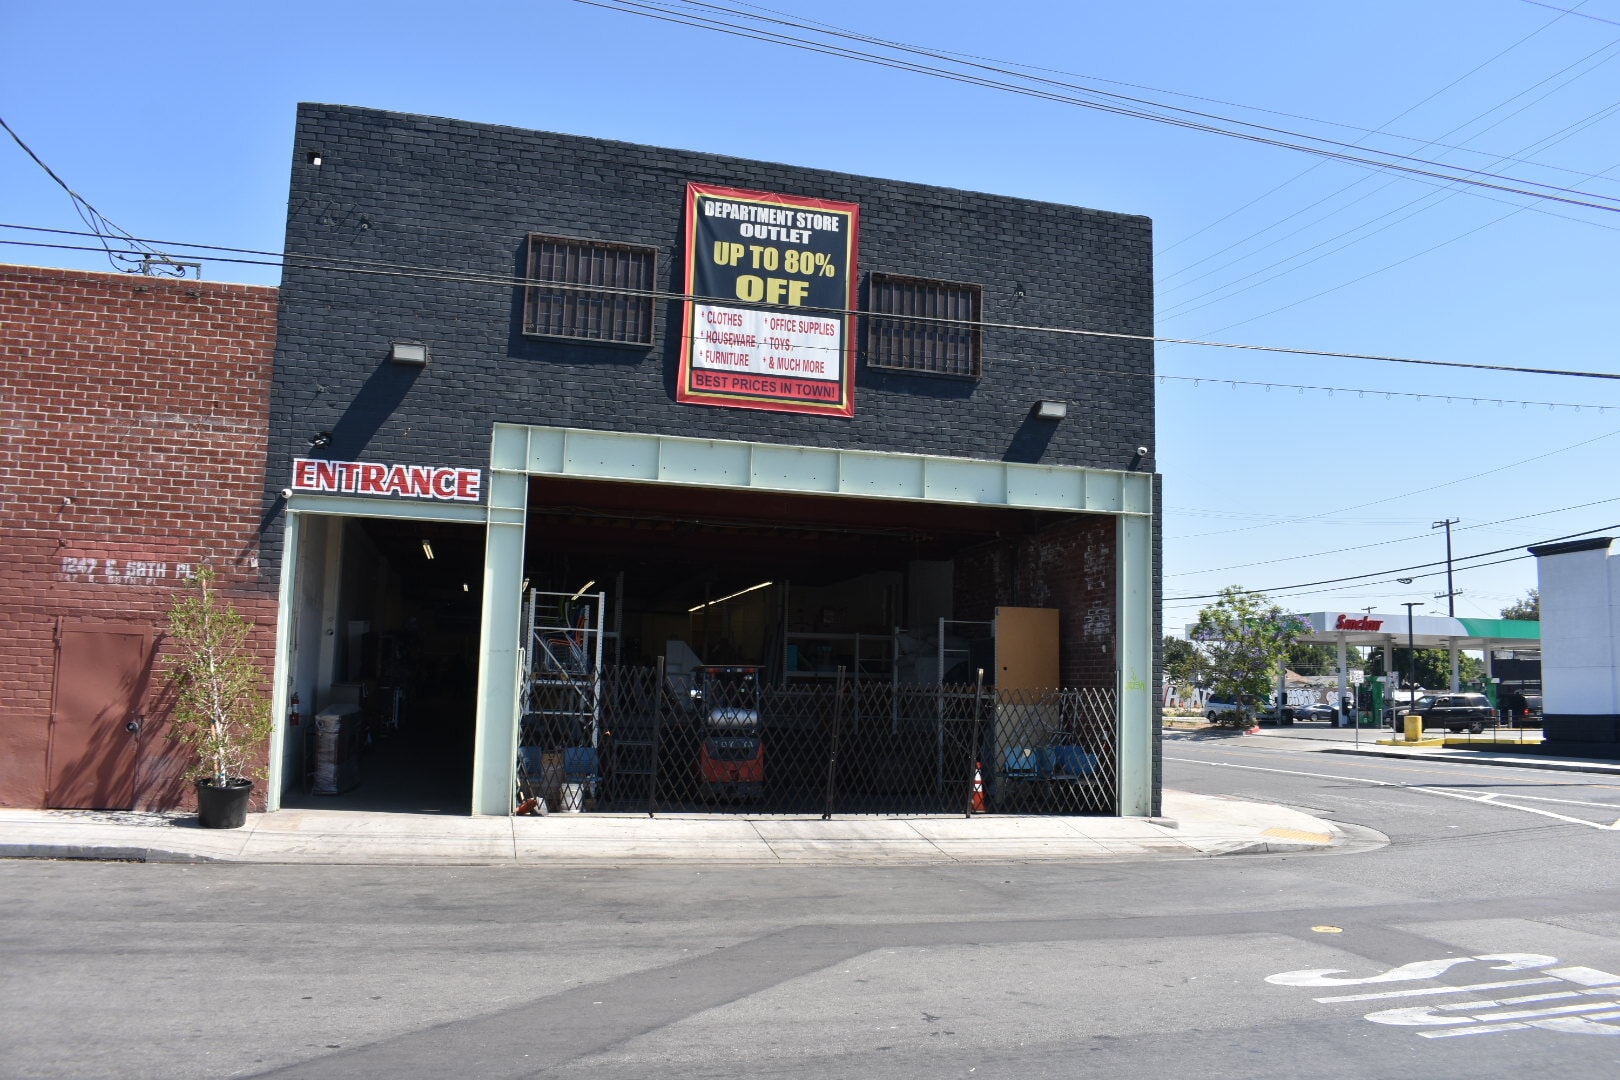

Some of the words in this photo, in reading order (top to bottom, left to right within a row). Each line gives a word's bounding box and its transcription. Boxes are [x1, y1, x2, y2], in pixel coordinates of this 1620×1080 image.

[704, 200, 795, 227] DEPARTMENT
[796, 212, 840, 232] STORE
[739, 222, 812, 245] OUTLET
[713, 240, 745, 267] UP
[749, 244, 779, 271] TO
[784, 248, 836, 278] 80%
[735, 274, 810, 306] OFF
[706, 310, 743, 327] CLOTHES
[769, 317, 796, 332] OFFICE
[798, 320, 835, 337] SUPPLIES
[705, 330, 756, 348] HOUSEWARE
[769, 336, 790, 351] TOYS
[705, 350, 749, 366] FURNITURE
[768, 356, 775, 370] &
[776, 356, 801, 372] MUCH
[802, 359, 825, 374] MORE
[695, 374, 729, 389] BEST
[732, 377, 777, 393] PRICES
[780, 382, 792, 393] IN
[795, 383, 835, 398] TOWN!
[292, 458, 481, 501] ENTRANCE
[62, 556, 98, 574] 1247
